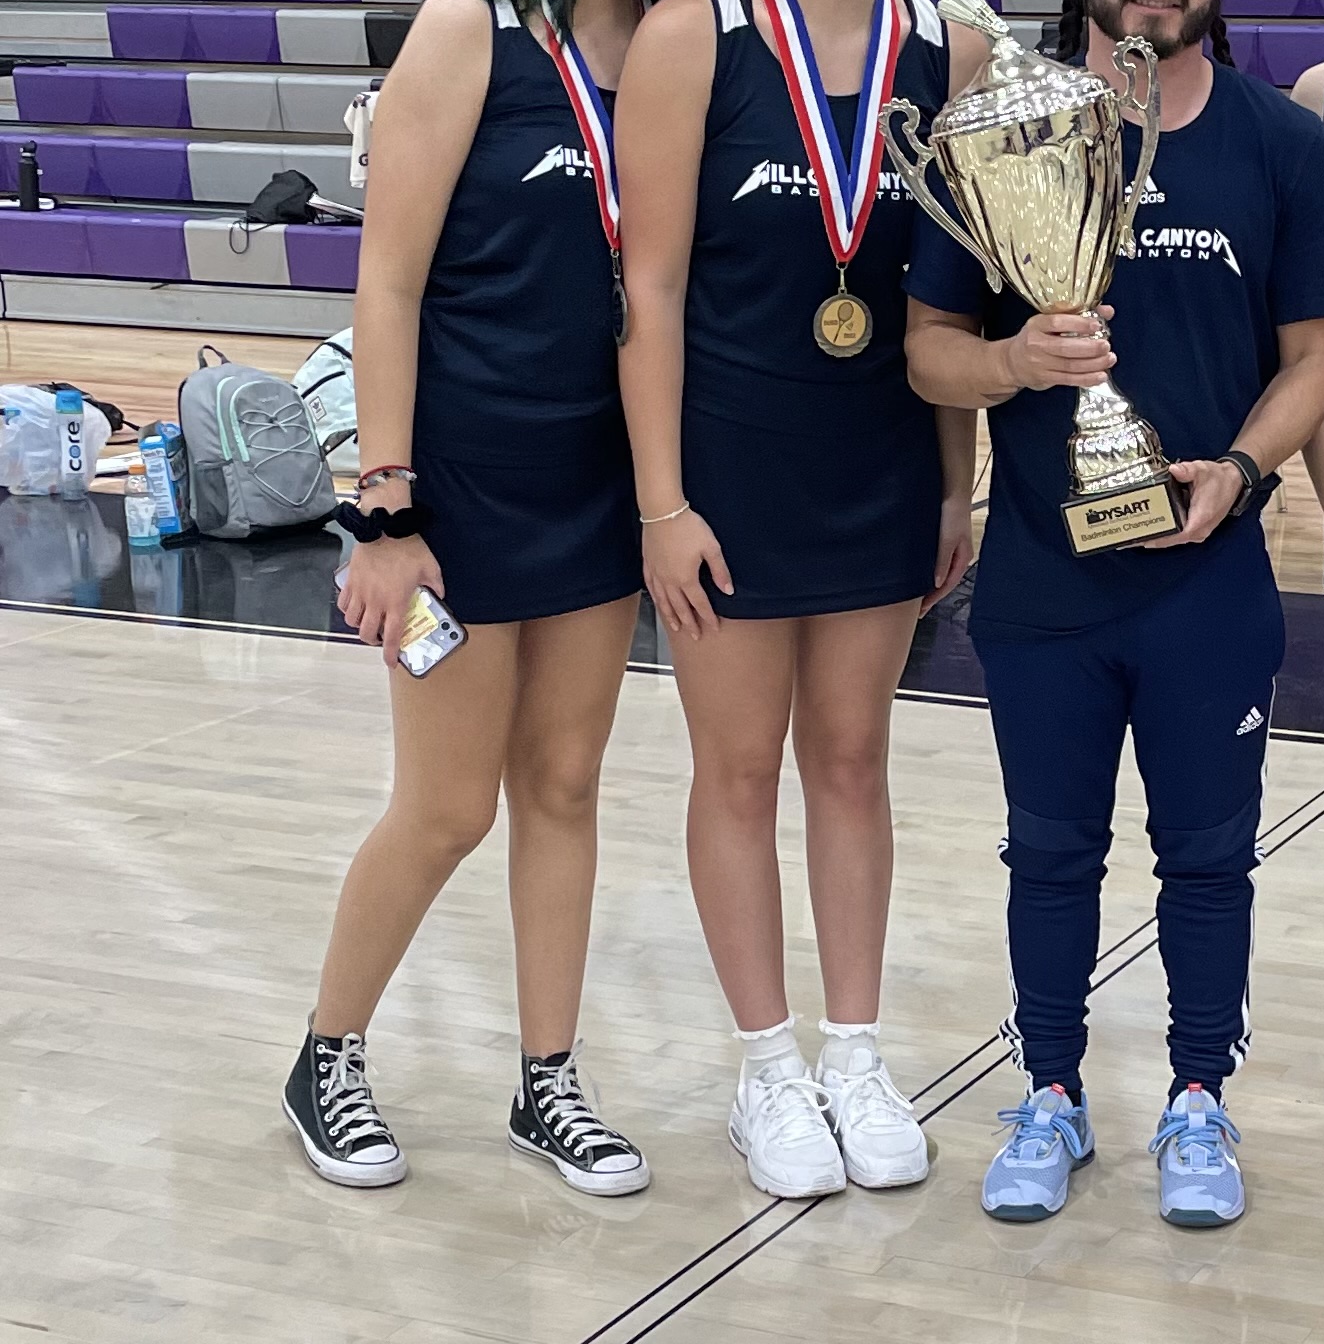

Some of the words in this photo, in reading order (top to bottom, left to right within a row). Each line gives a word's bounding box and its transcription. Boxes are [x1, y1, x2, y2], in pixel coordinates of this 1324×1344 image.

[67, 421, 82, 472] core
[1096, 499, 1151, 521] DYSART
[1081, 526, 1122, 542] Badminton
[1122, 515, 1166, 532] Champions
